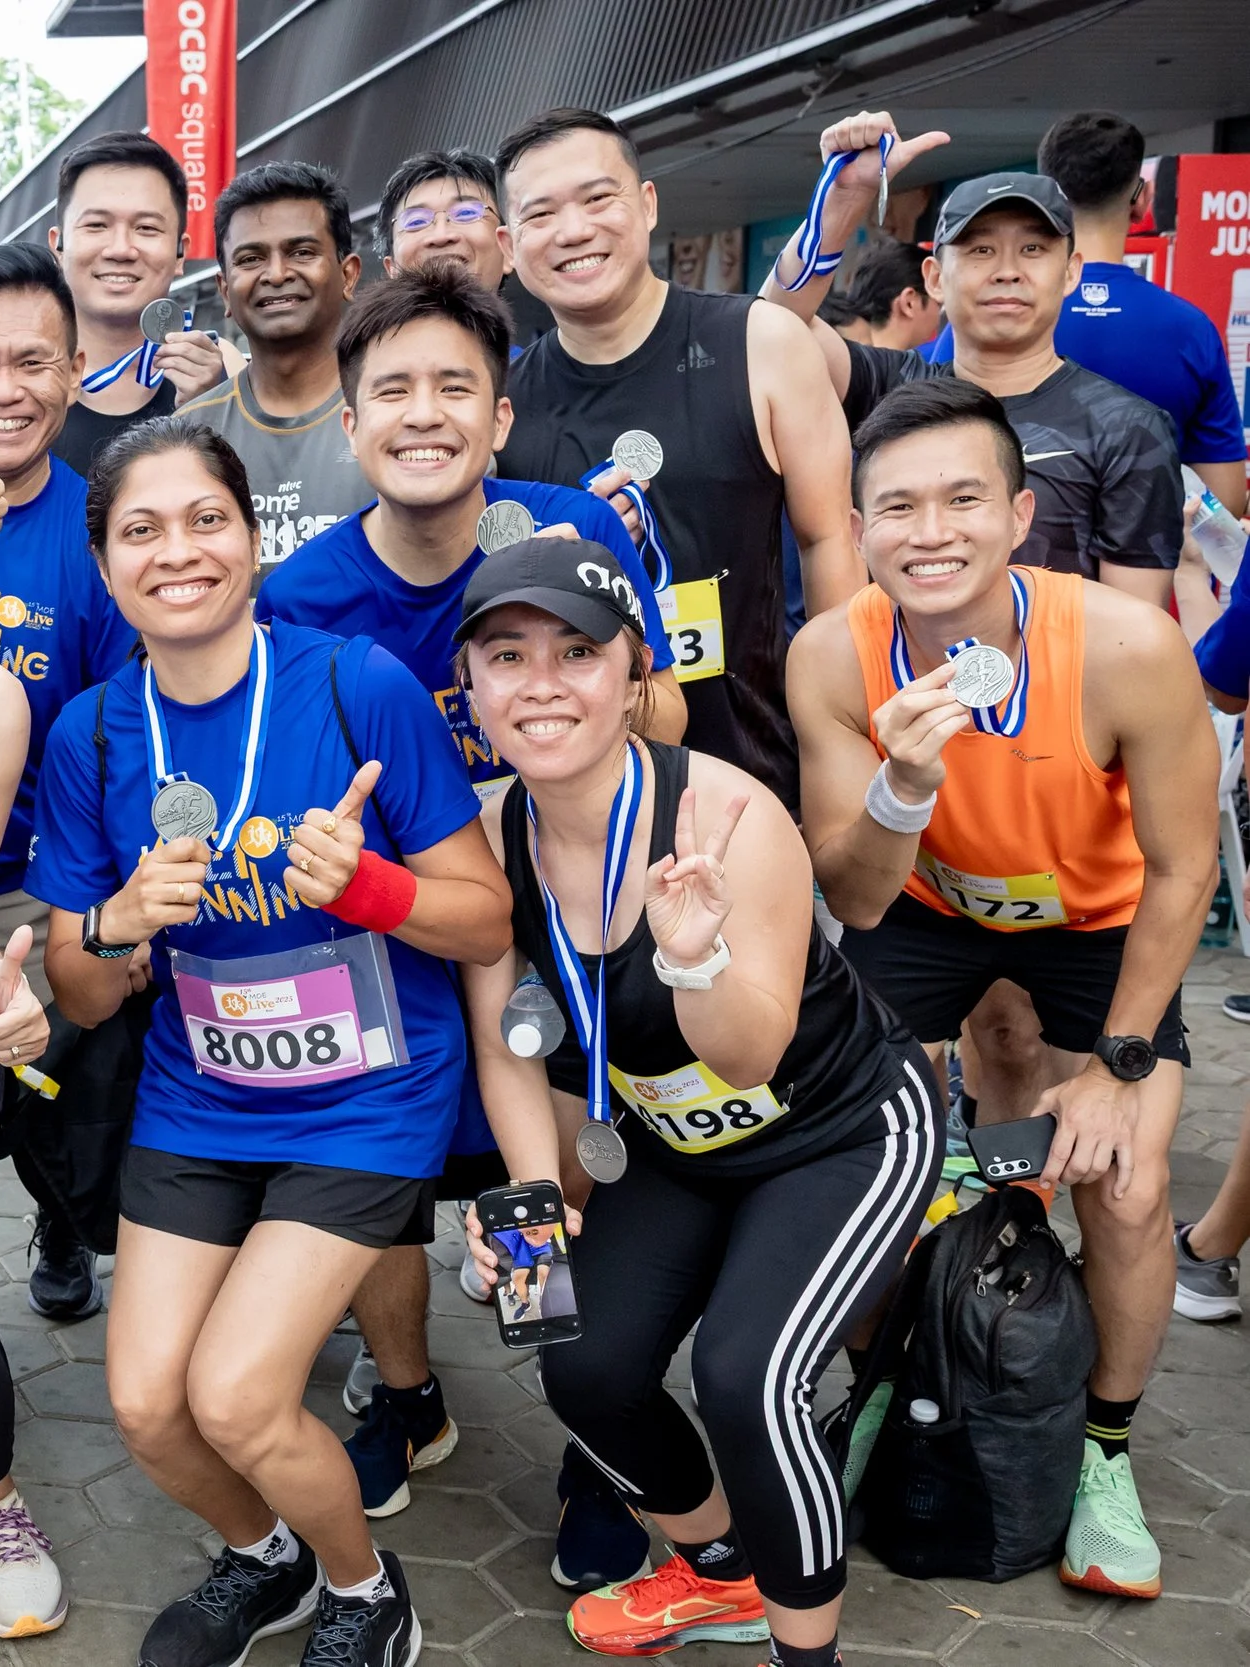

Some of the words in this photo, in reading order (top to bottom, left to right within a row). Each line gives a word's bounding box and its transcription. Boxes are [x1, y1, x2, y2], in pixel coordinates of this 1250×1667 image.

[178, 0, 207, 95] OCBC
[175, 102, 207, 212] square
[1201, 191, 1250, 221] MO
[26, 611, 54, 626] Live
[289, 813, 305, 824] MO
[278, 825, 295, 842] Li
[249, 1000, 275, 1010] Live
[275, 995, 293, 1003] 2025
[203, 1023, 341, 1071] 8008
[657, 1087, 684, 1097] Live
[697, 1546, 735, 1564] adidas
